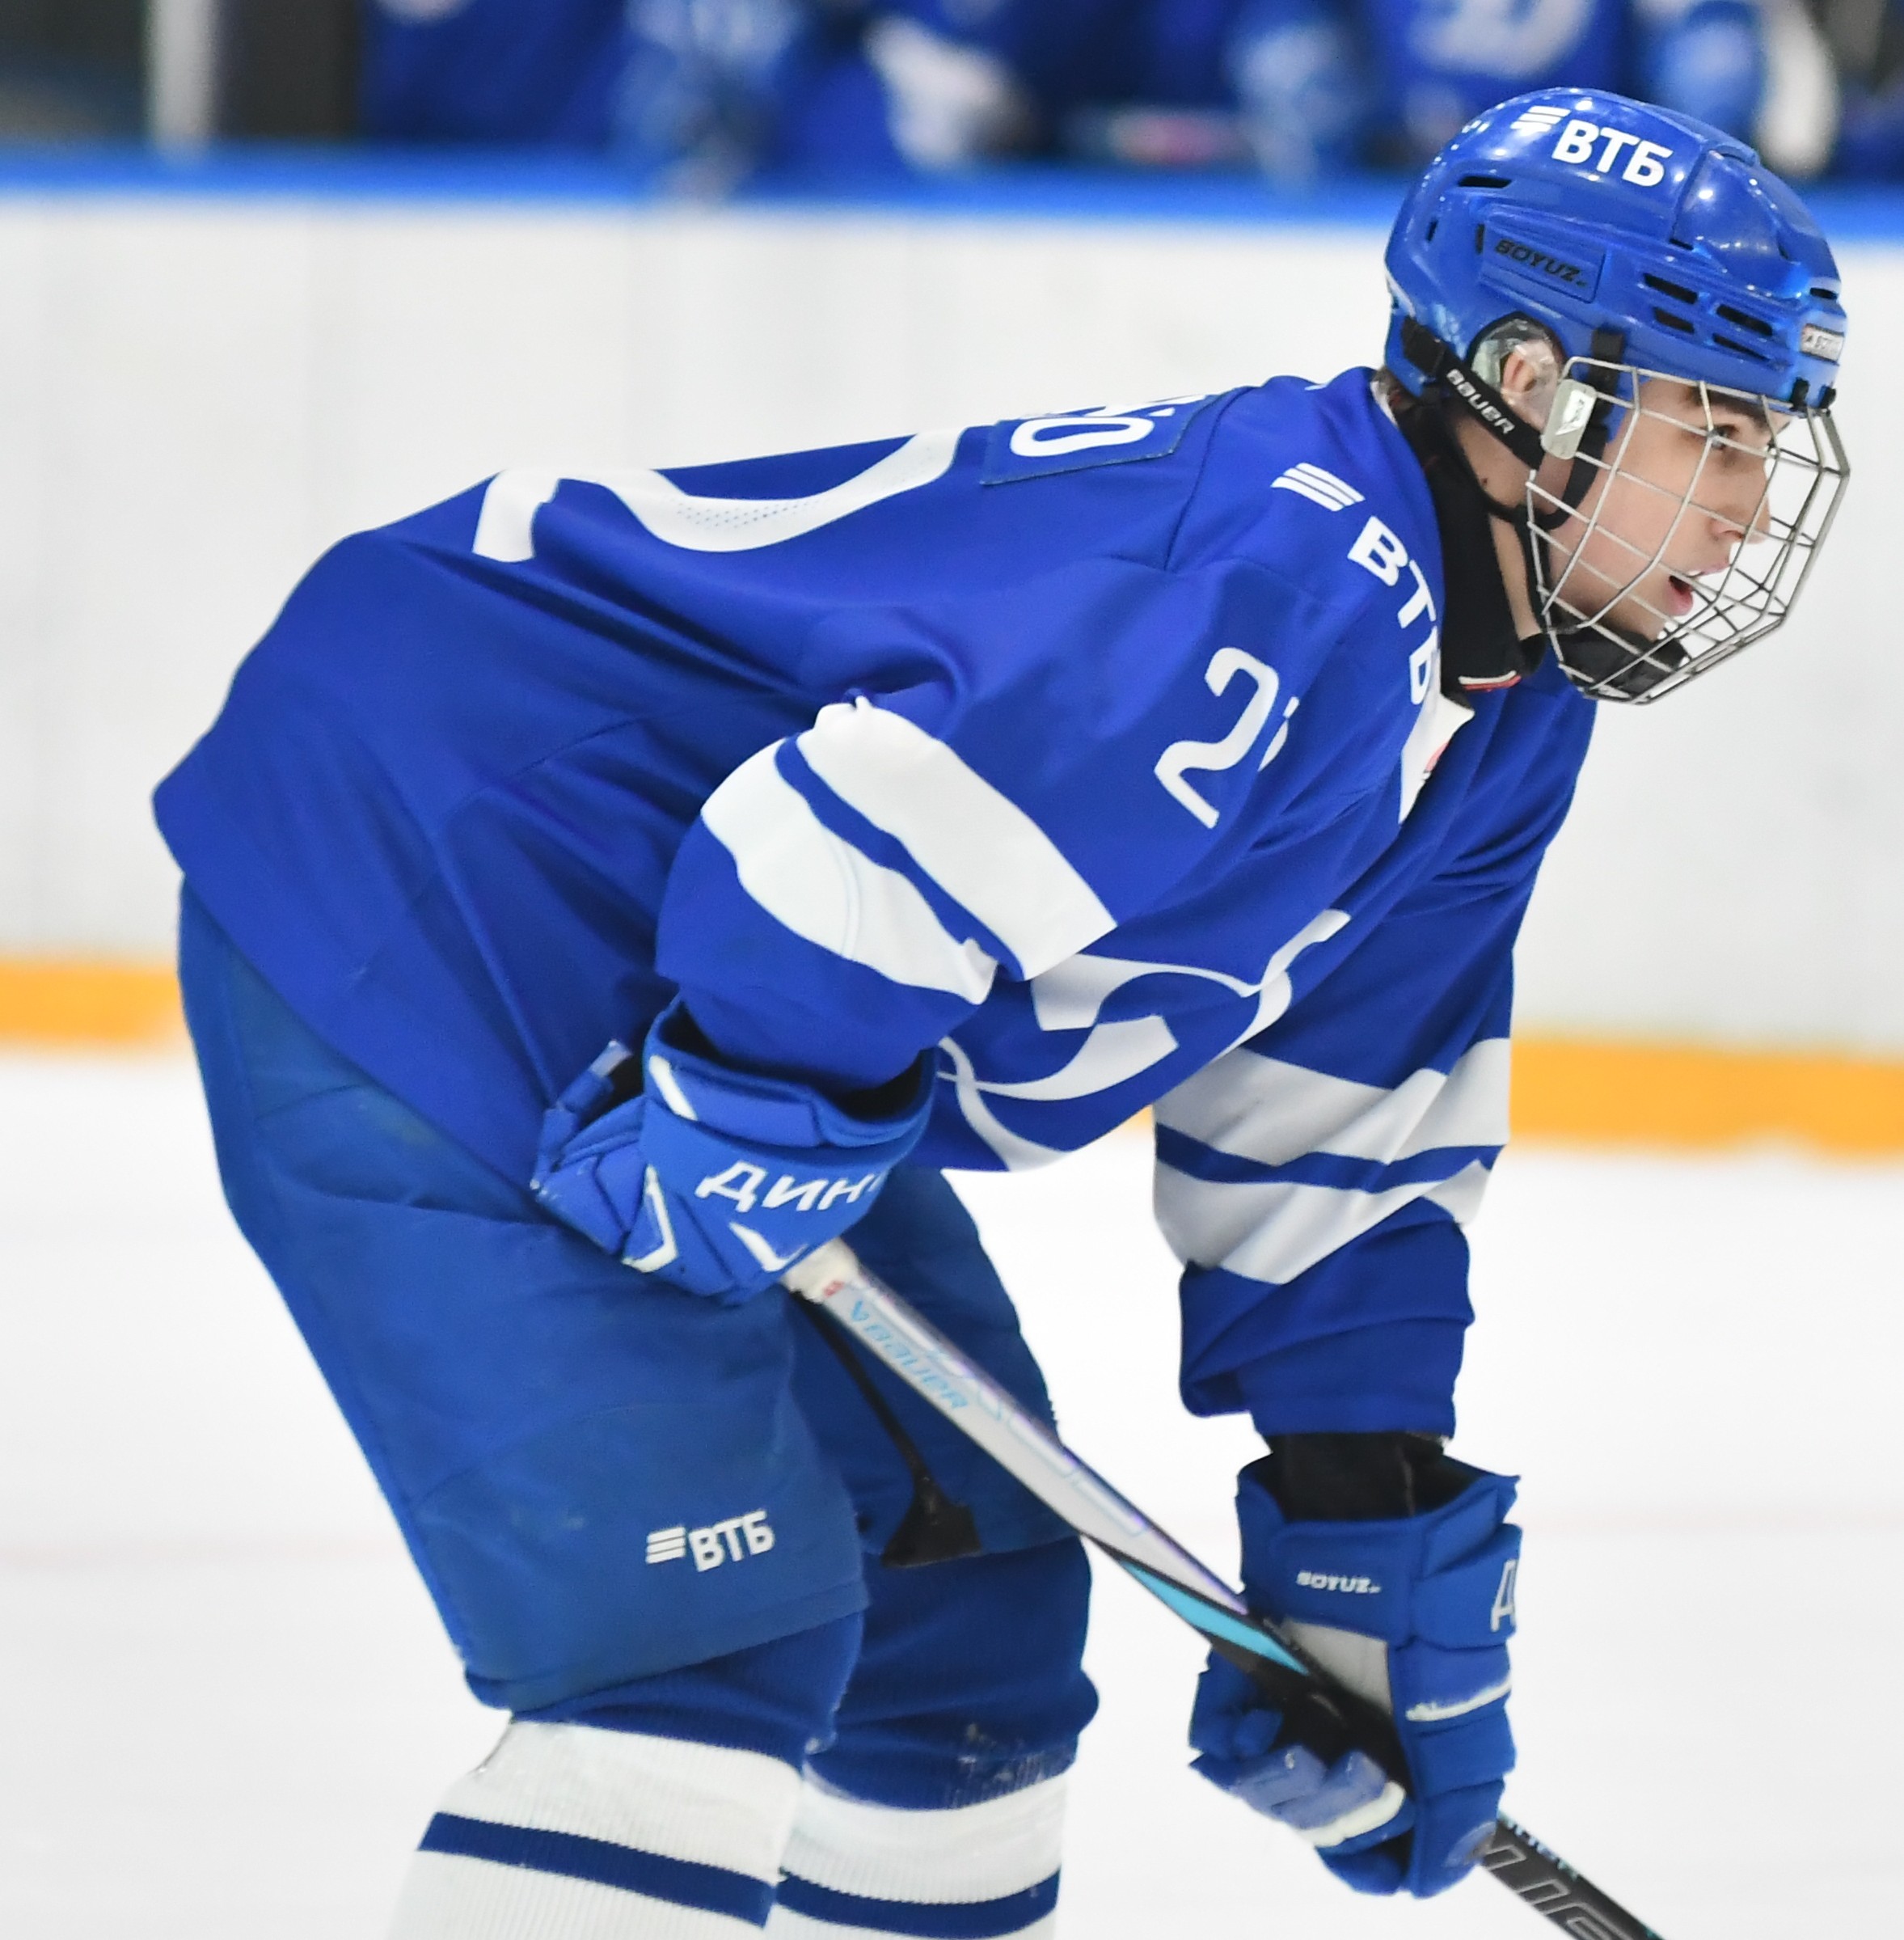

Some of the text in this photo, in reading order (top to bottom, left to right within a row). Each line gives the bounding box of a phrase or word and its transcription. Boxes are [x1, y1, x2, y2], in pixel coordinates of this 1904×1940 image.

[1551, 120, 1674, 187] ВТБ
[1496, 238, 1583, 282] SOYUZ
[694, 1160, 888, 1213] ДИН
[689, 1509, 775, 1571] ВТБ
[1296, 1570, 1373, 1593] SOYUZ
